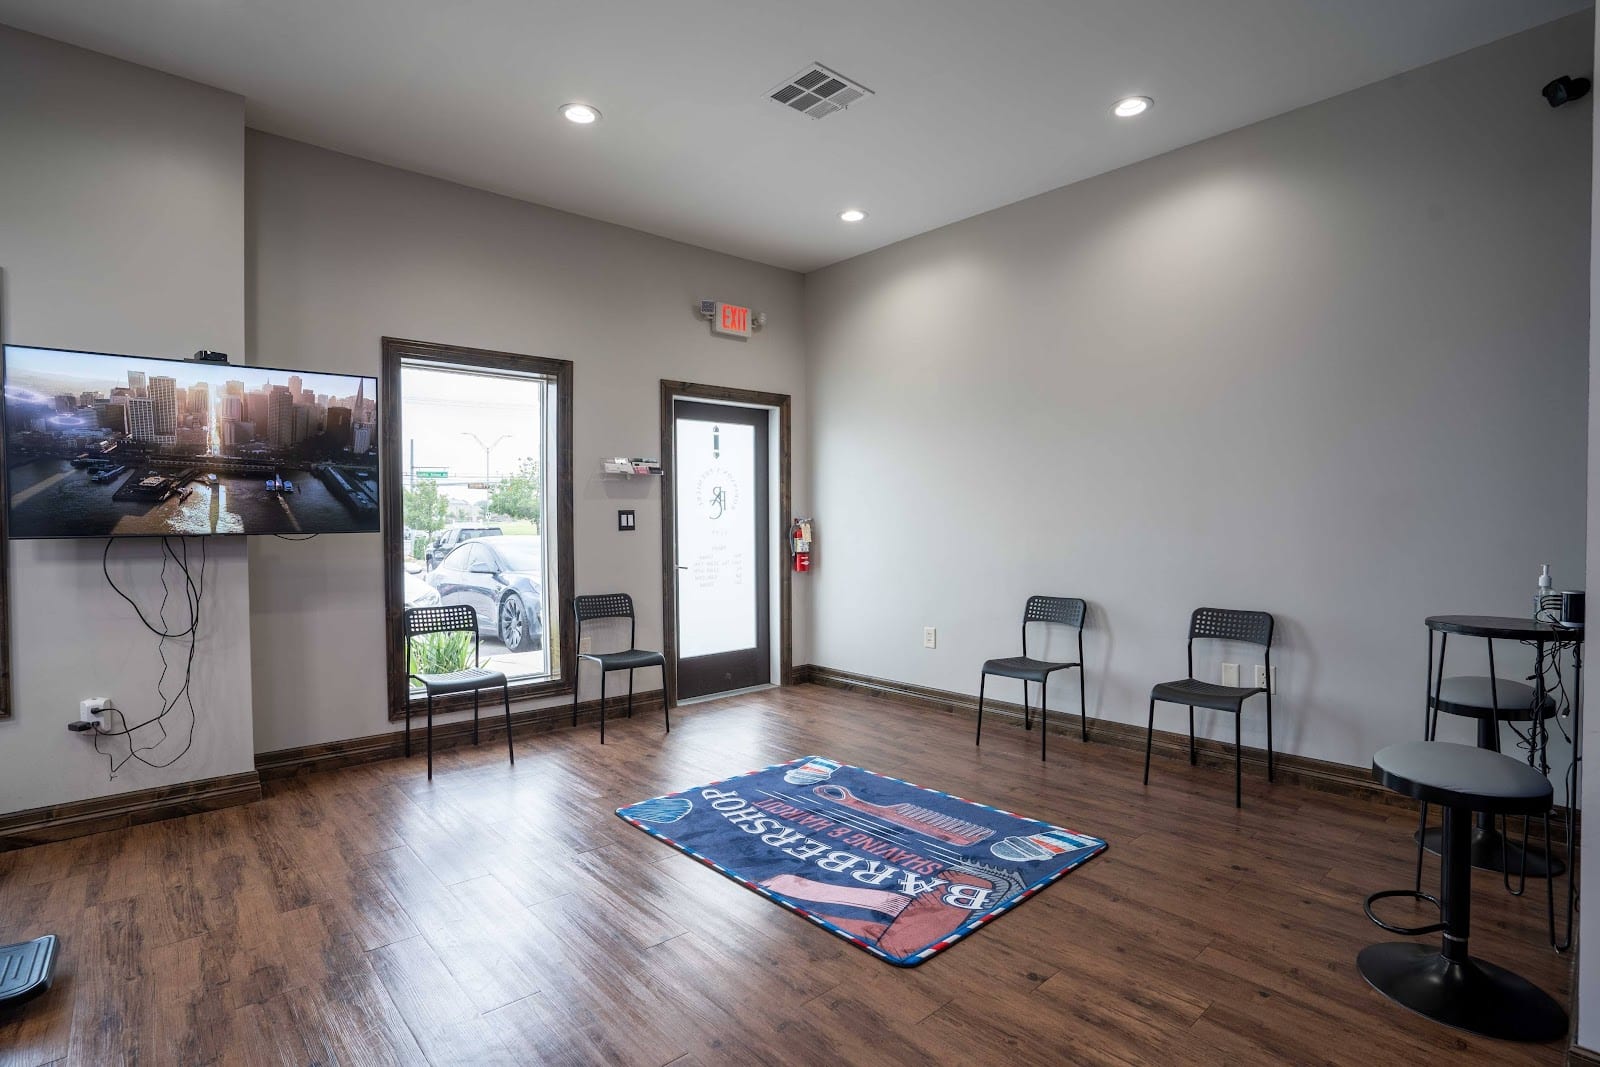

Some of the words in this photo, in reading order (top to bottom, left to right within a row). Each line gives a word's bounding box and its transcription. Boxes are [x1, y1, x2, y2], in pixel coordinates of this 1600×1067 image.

[722, 304, 747, 332] EXIT
[752, 799, 836, 832] HAIRCUT
[701, 788, 992, 910] BARBERSHOP
[828, 828, 841, 838] &
[843, 833, 944, 876] SHAVING
